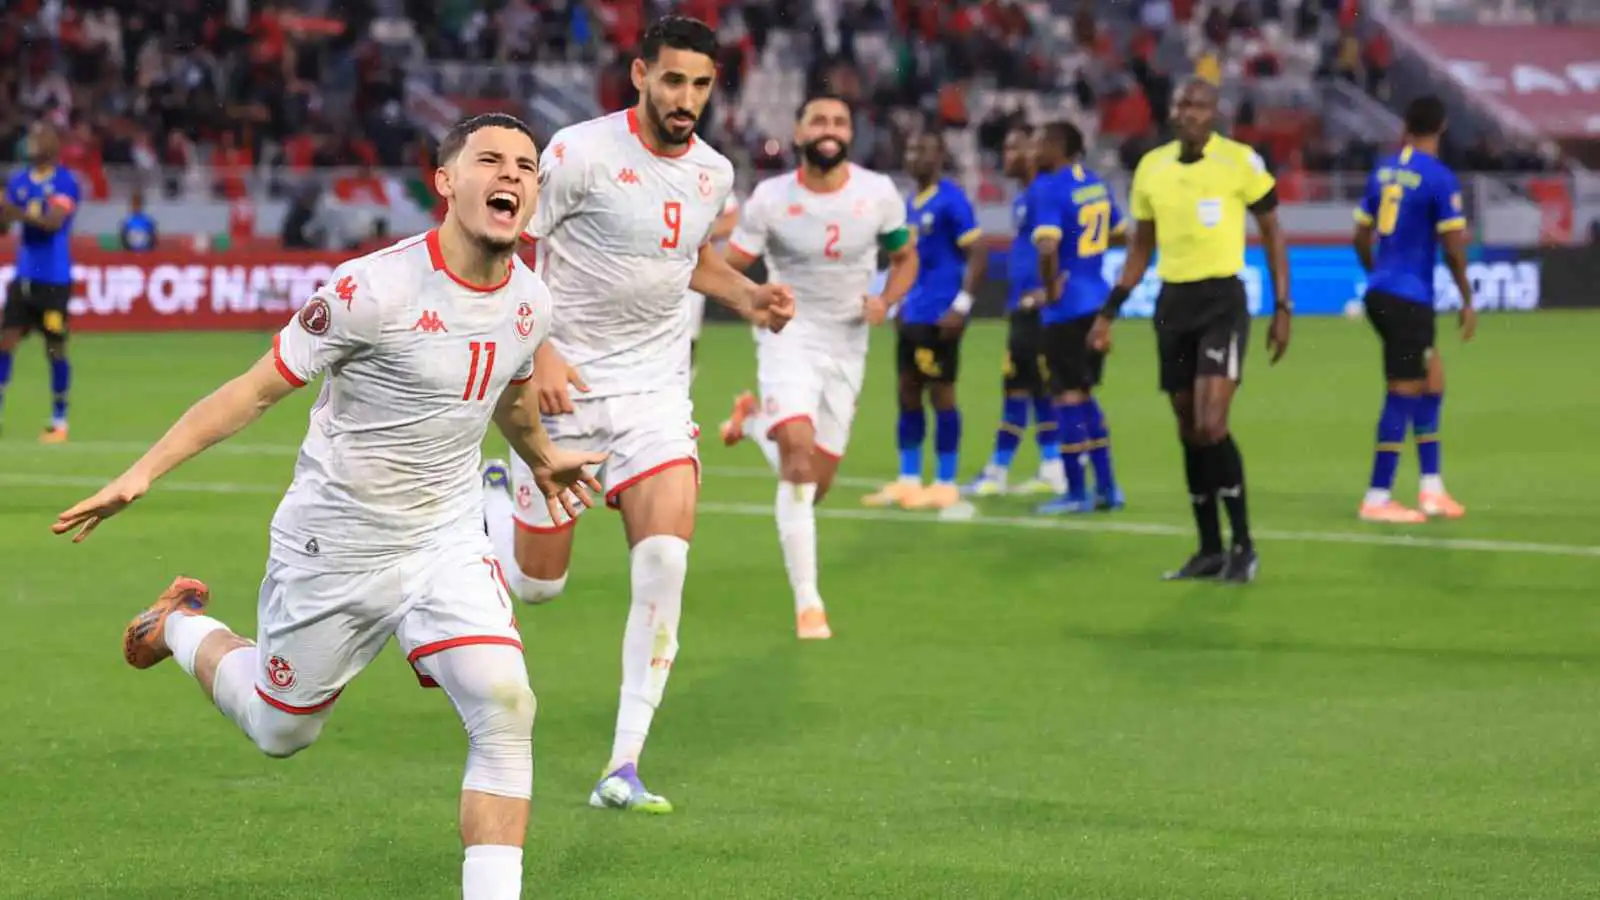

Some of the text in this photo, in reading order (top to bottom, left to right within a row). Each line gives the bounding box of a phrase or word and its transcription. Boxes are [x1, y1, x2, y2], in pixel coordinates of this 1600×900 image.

[660, 201, 681, 249] 9
[824, 224, 841, 260] 2
[1078, 200, 1111, 257] 27
[149, 263, 208, 314] OF
[462, 341, 497, 401] 11
